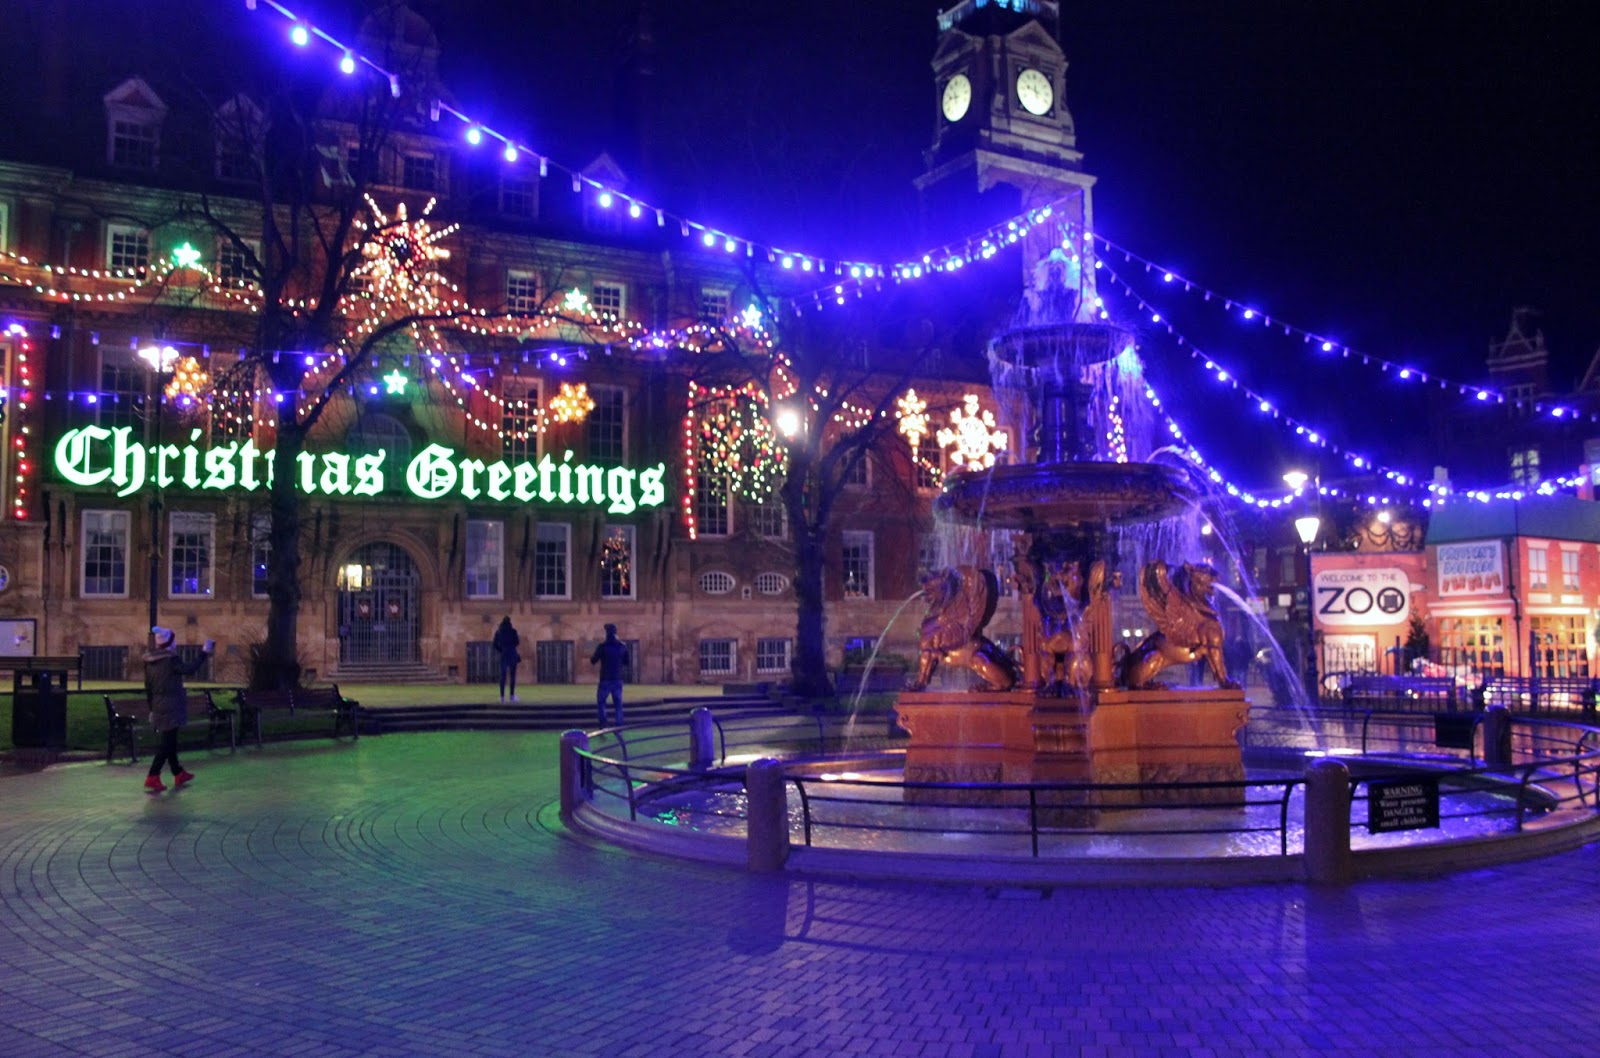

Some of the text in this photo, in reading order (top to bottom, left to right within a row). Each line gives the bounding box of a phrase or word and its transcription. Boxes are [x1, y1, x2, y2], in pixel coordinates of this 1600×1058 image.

[406, 443, 665, 514] Greetings
[1321, 573, 1397, 582] WELCOME TO THE
[1318, 587, 1405, 614] ZOO
[1383, 785, 1423, 797] WARNING
[1383, 807, 1414, 818] DANGER
[1380, 816, 1426, 827] small children
